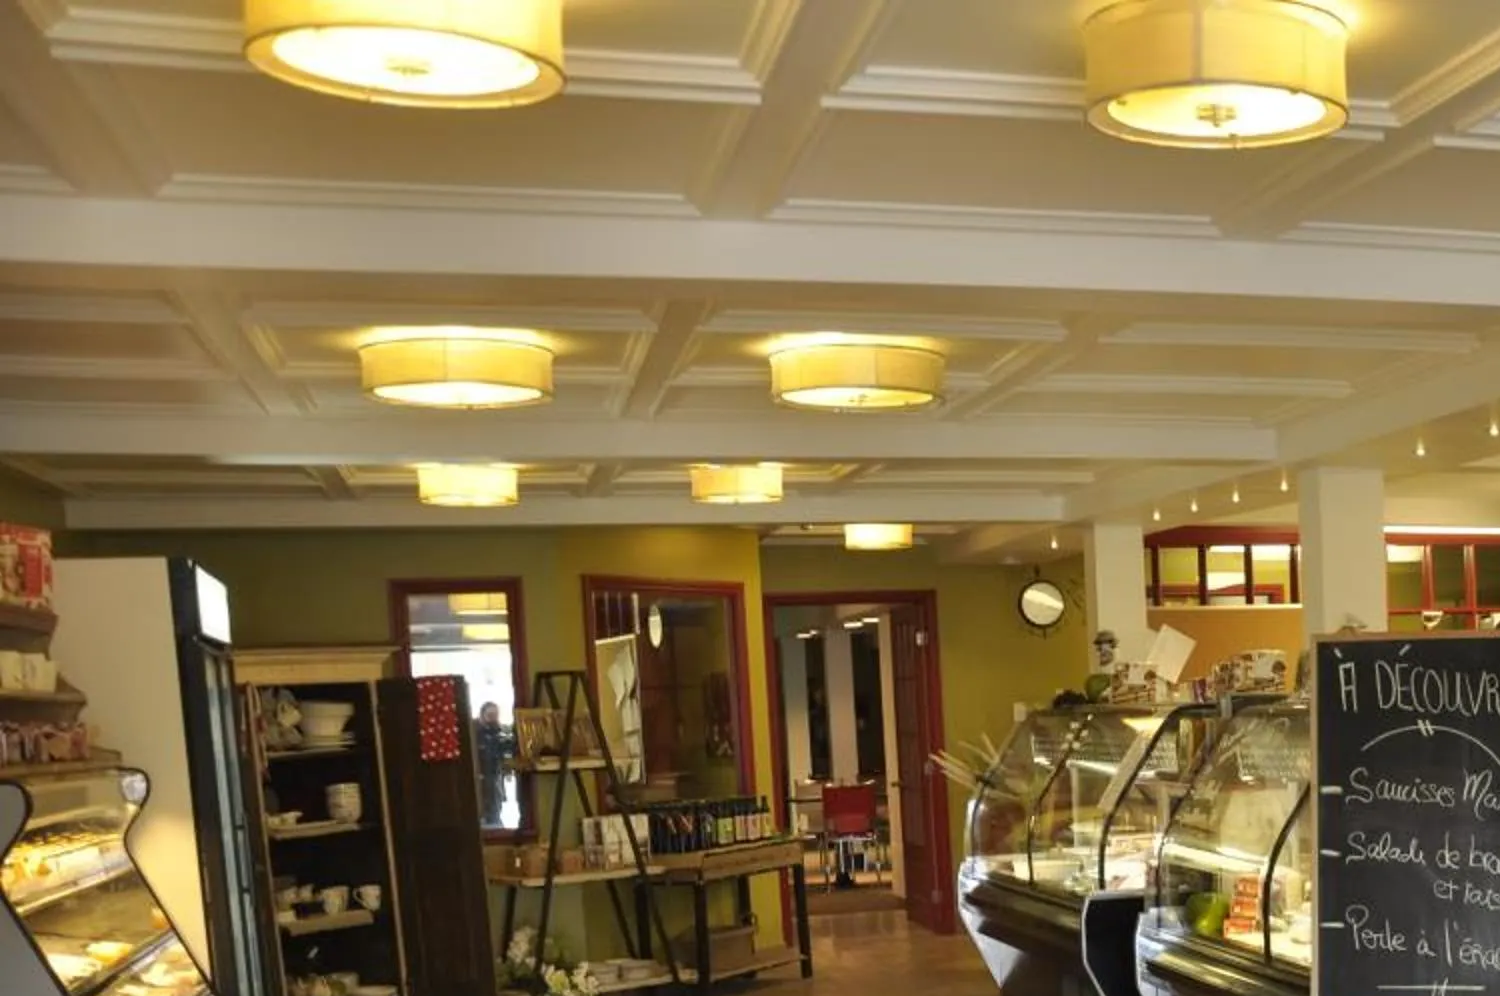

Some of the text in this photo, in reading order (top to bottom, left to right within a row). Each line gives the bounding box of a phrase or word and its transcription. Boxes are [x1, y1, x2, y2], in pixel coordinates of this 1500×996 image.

[1333, 647, 1359, 714] À
[1345, 766, 1456, 808] Saucisses
[1345, 830, 1427, 866] Salade
[1435, 830, 1461, 870] de
[1433, 878, 1460, 901] et
[1416, 928, 1437, 958] à
